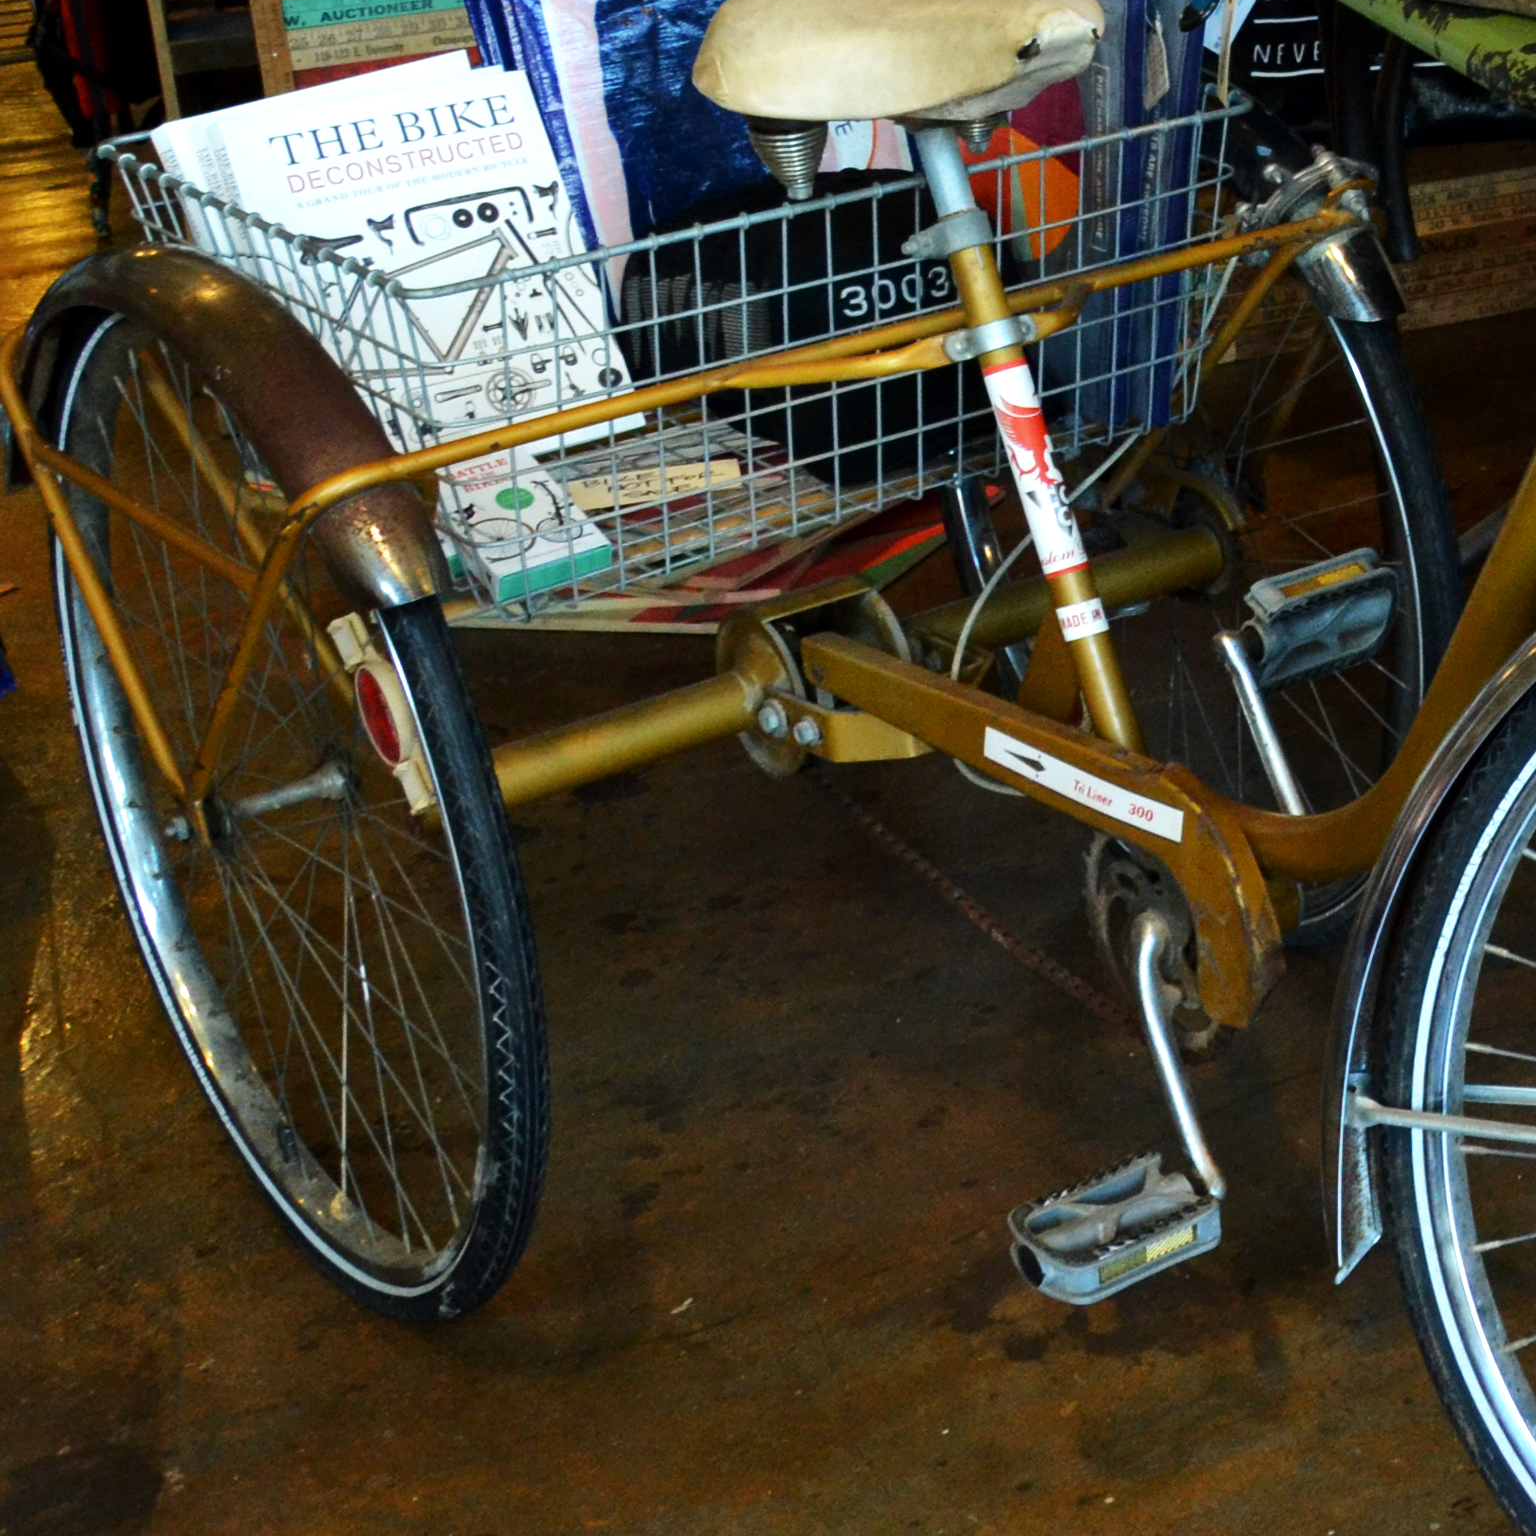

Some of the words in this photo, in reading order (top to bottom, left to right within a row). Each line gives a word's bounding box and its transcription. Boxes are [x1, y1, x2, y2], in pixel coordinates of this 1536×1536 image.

[1252, 40, 1322, 64] NEVE
[268, 118, 385, 167] THE
[392, 93, 516, 145] BIKE
[286, 131, 524, 195] DECONSTRUCTED
[306, 191, 349, 209] GRAND
[431, 165, 480, 182] MODERN
[1060, 612, 1090, 631] MADE
[1127, 802, 1155, 823] 300
